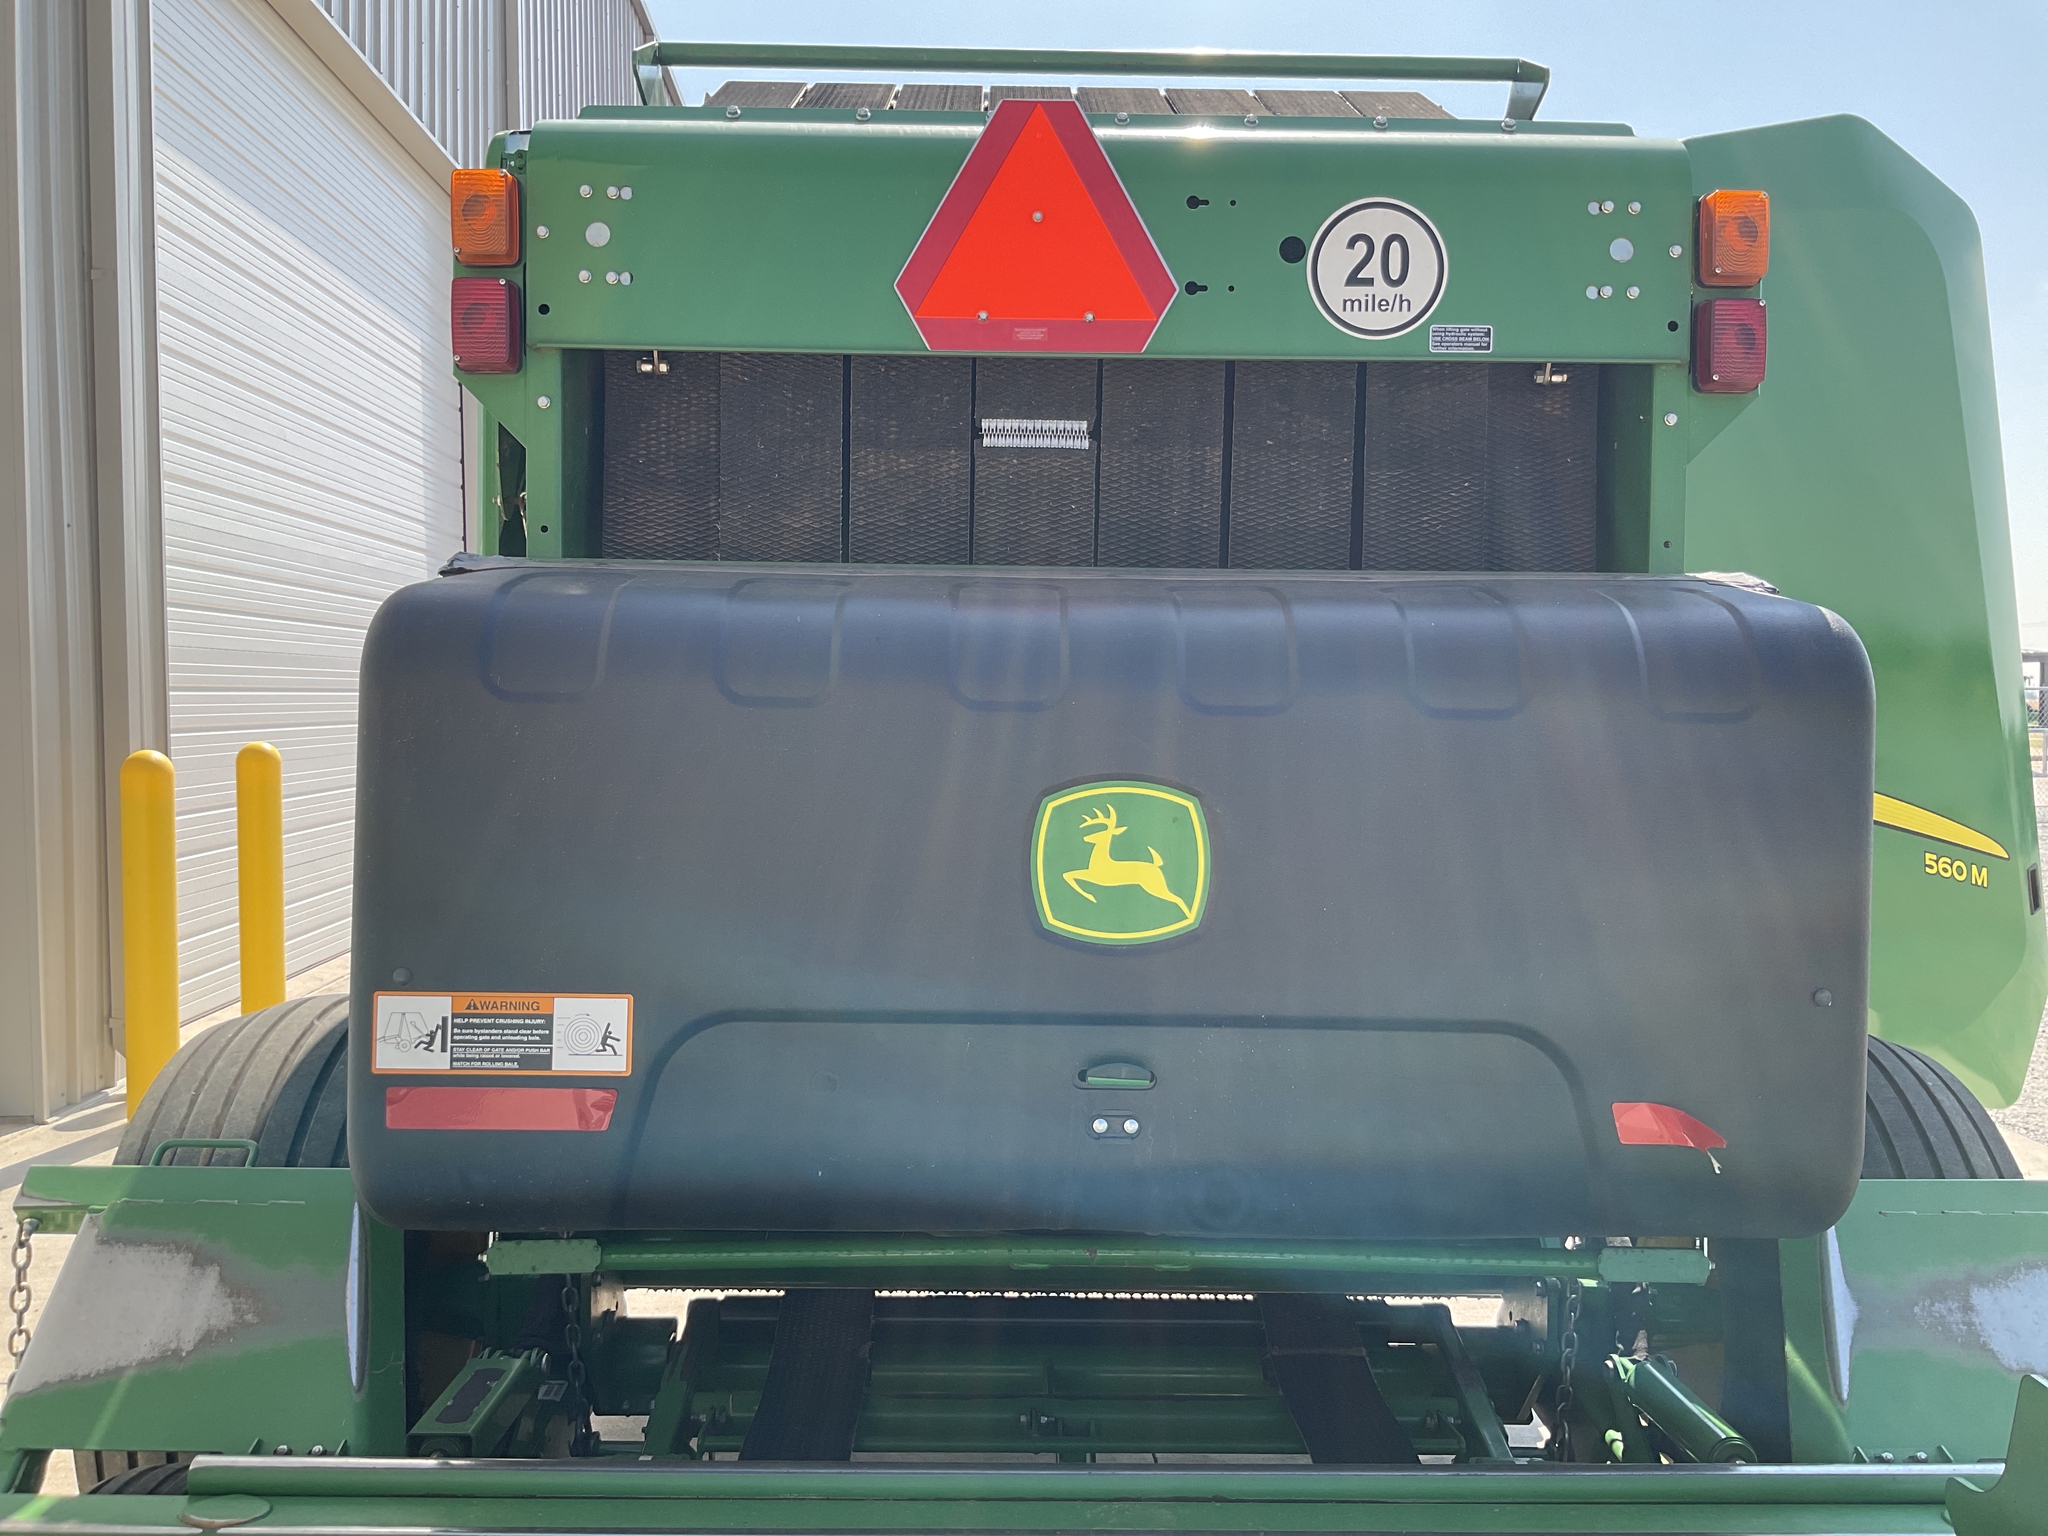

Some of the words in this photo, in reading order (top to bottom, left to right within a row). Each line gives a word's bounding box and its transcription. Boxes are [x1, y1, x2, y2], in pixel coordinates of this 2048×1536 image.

[1344, 233, 1410, 288] 20
[1342, 293, 1411, 312] mile/h
[1924, 851, 1967, 882] 560
[1971, 862, 1988, 888] M
[479, 1001, 540, 1011] WARNING
